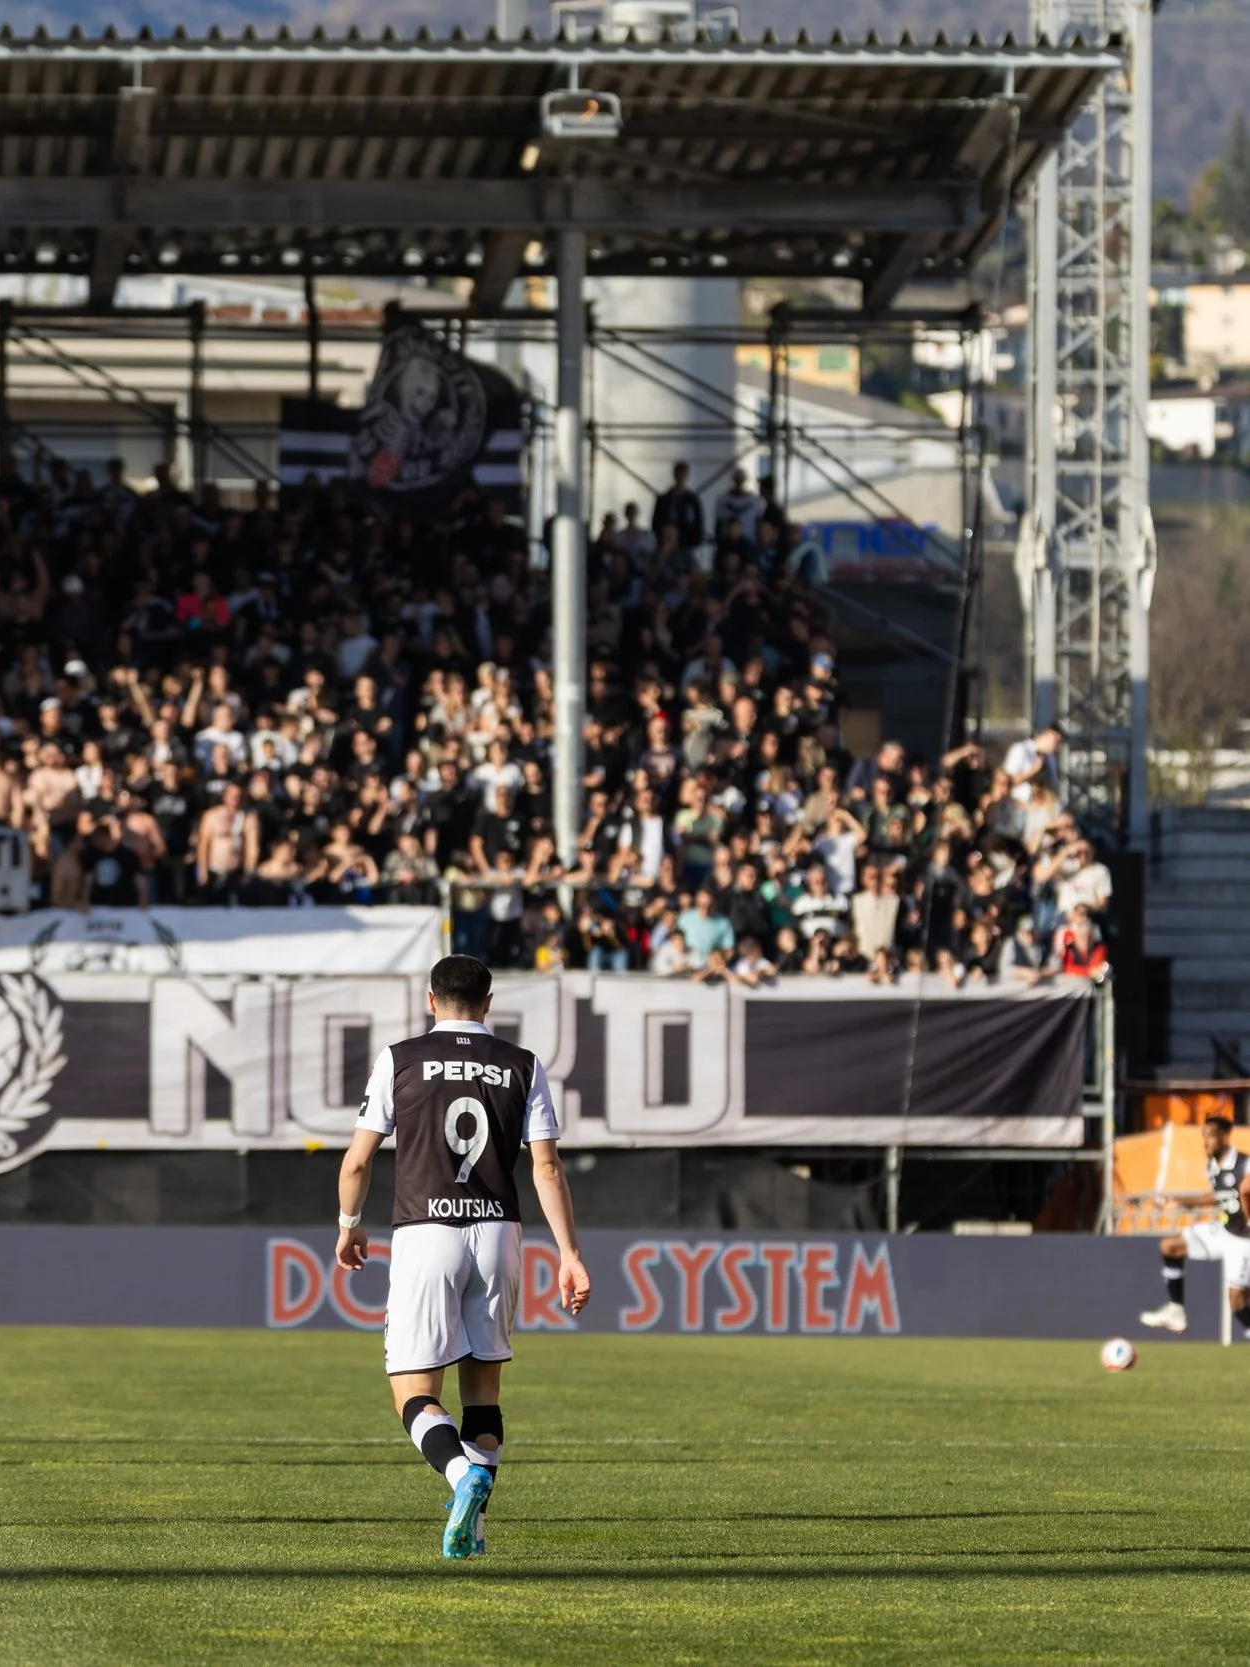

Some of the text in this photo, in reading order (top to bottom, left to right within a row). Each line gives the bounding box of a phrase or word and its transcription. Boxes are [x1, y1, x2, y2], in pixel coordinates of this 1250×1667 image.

[423, 1060, 511, 1088] PEPSI
[444, 1096, 488, 1183] 9
[428, 1199, 504, 1218] KOUTSIAS
[267, 1238, 902, 1334] DOR SYSTEM
